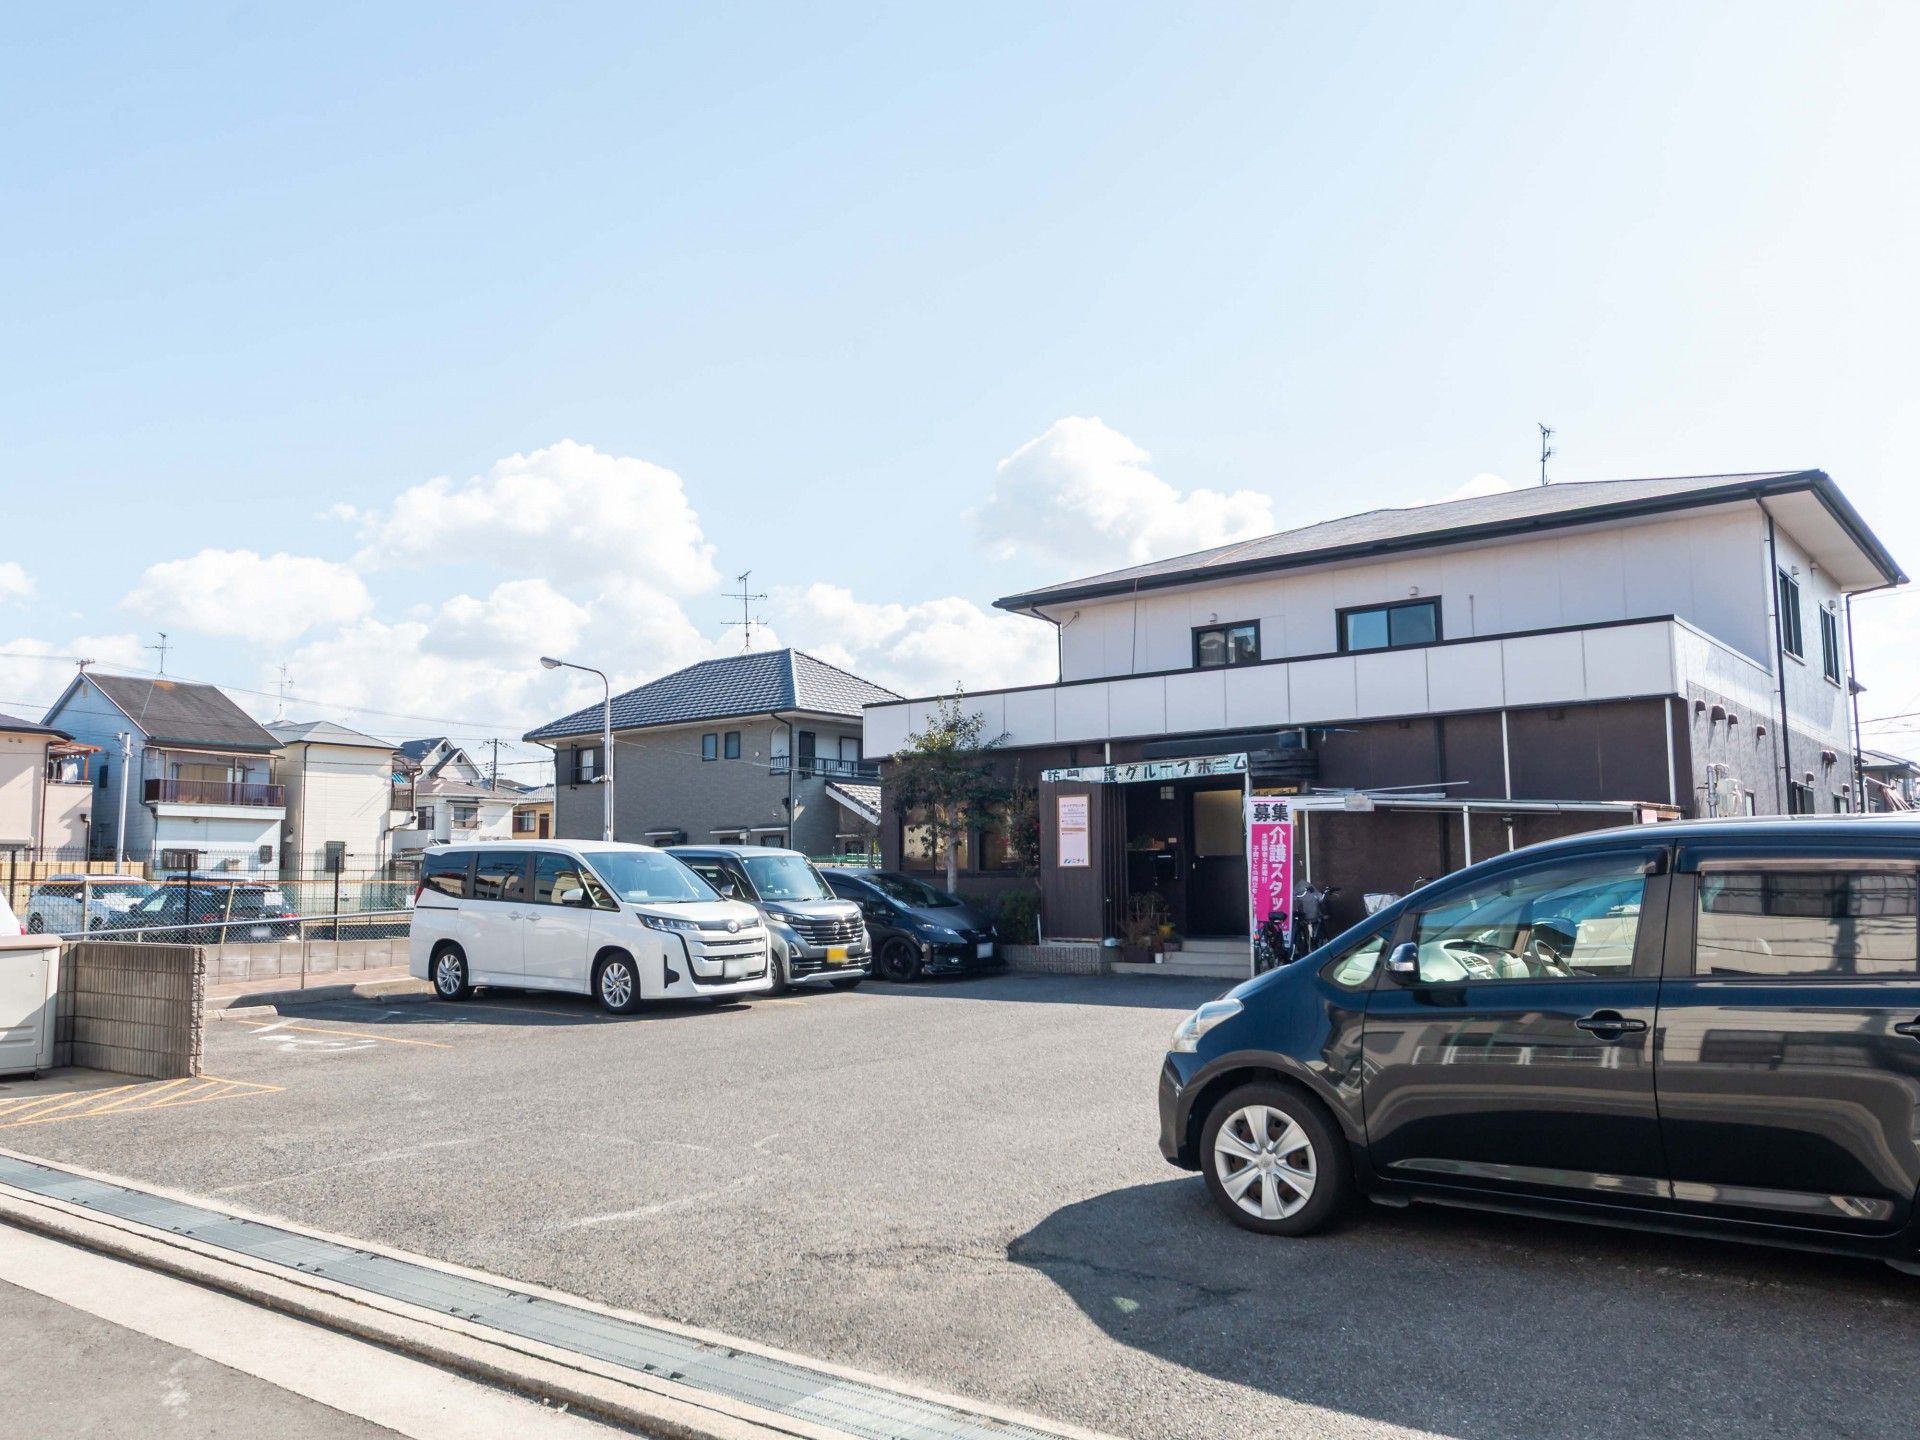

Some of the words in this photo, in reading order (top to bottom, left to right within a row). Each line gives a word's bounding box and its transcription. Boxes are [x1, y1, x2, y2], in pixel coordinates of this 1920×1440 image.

[1254, 803, 1289, 822] 募集
[1269, 826, 1287, 911] 介護スタッ
